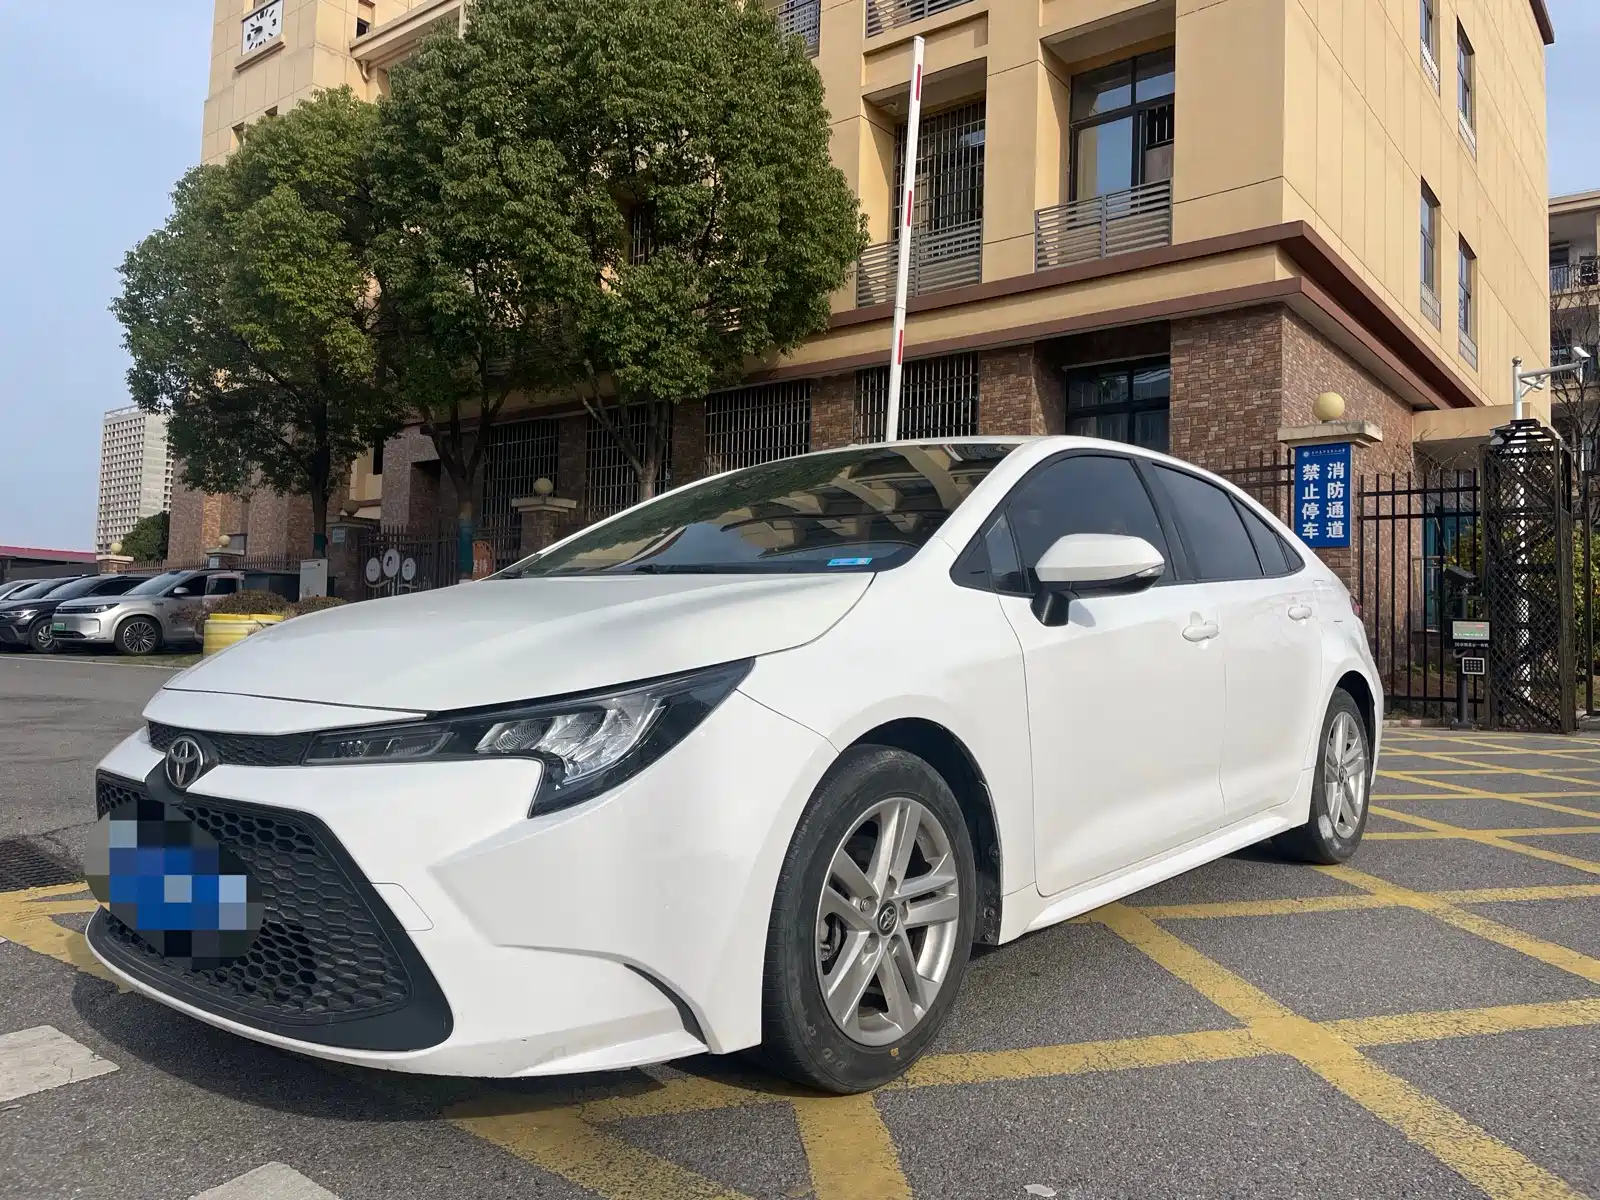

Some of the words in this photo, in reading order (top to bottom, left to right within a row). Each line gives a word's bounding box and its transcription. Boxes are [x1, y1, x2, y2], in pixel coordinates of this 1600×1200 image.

[1301, 463, 1320, 539] 禁止停车
[1326, 461, 1345, 538] 消防通道
